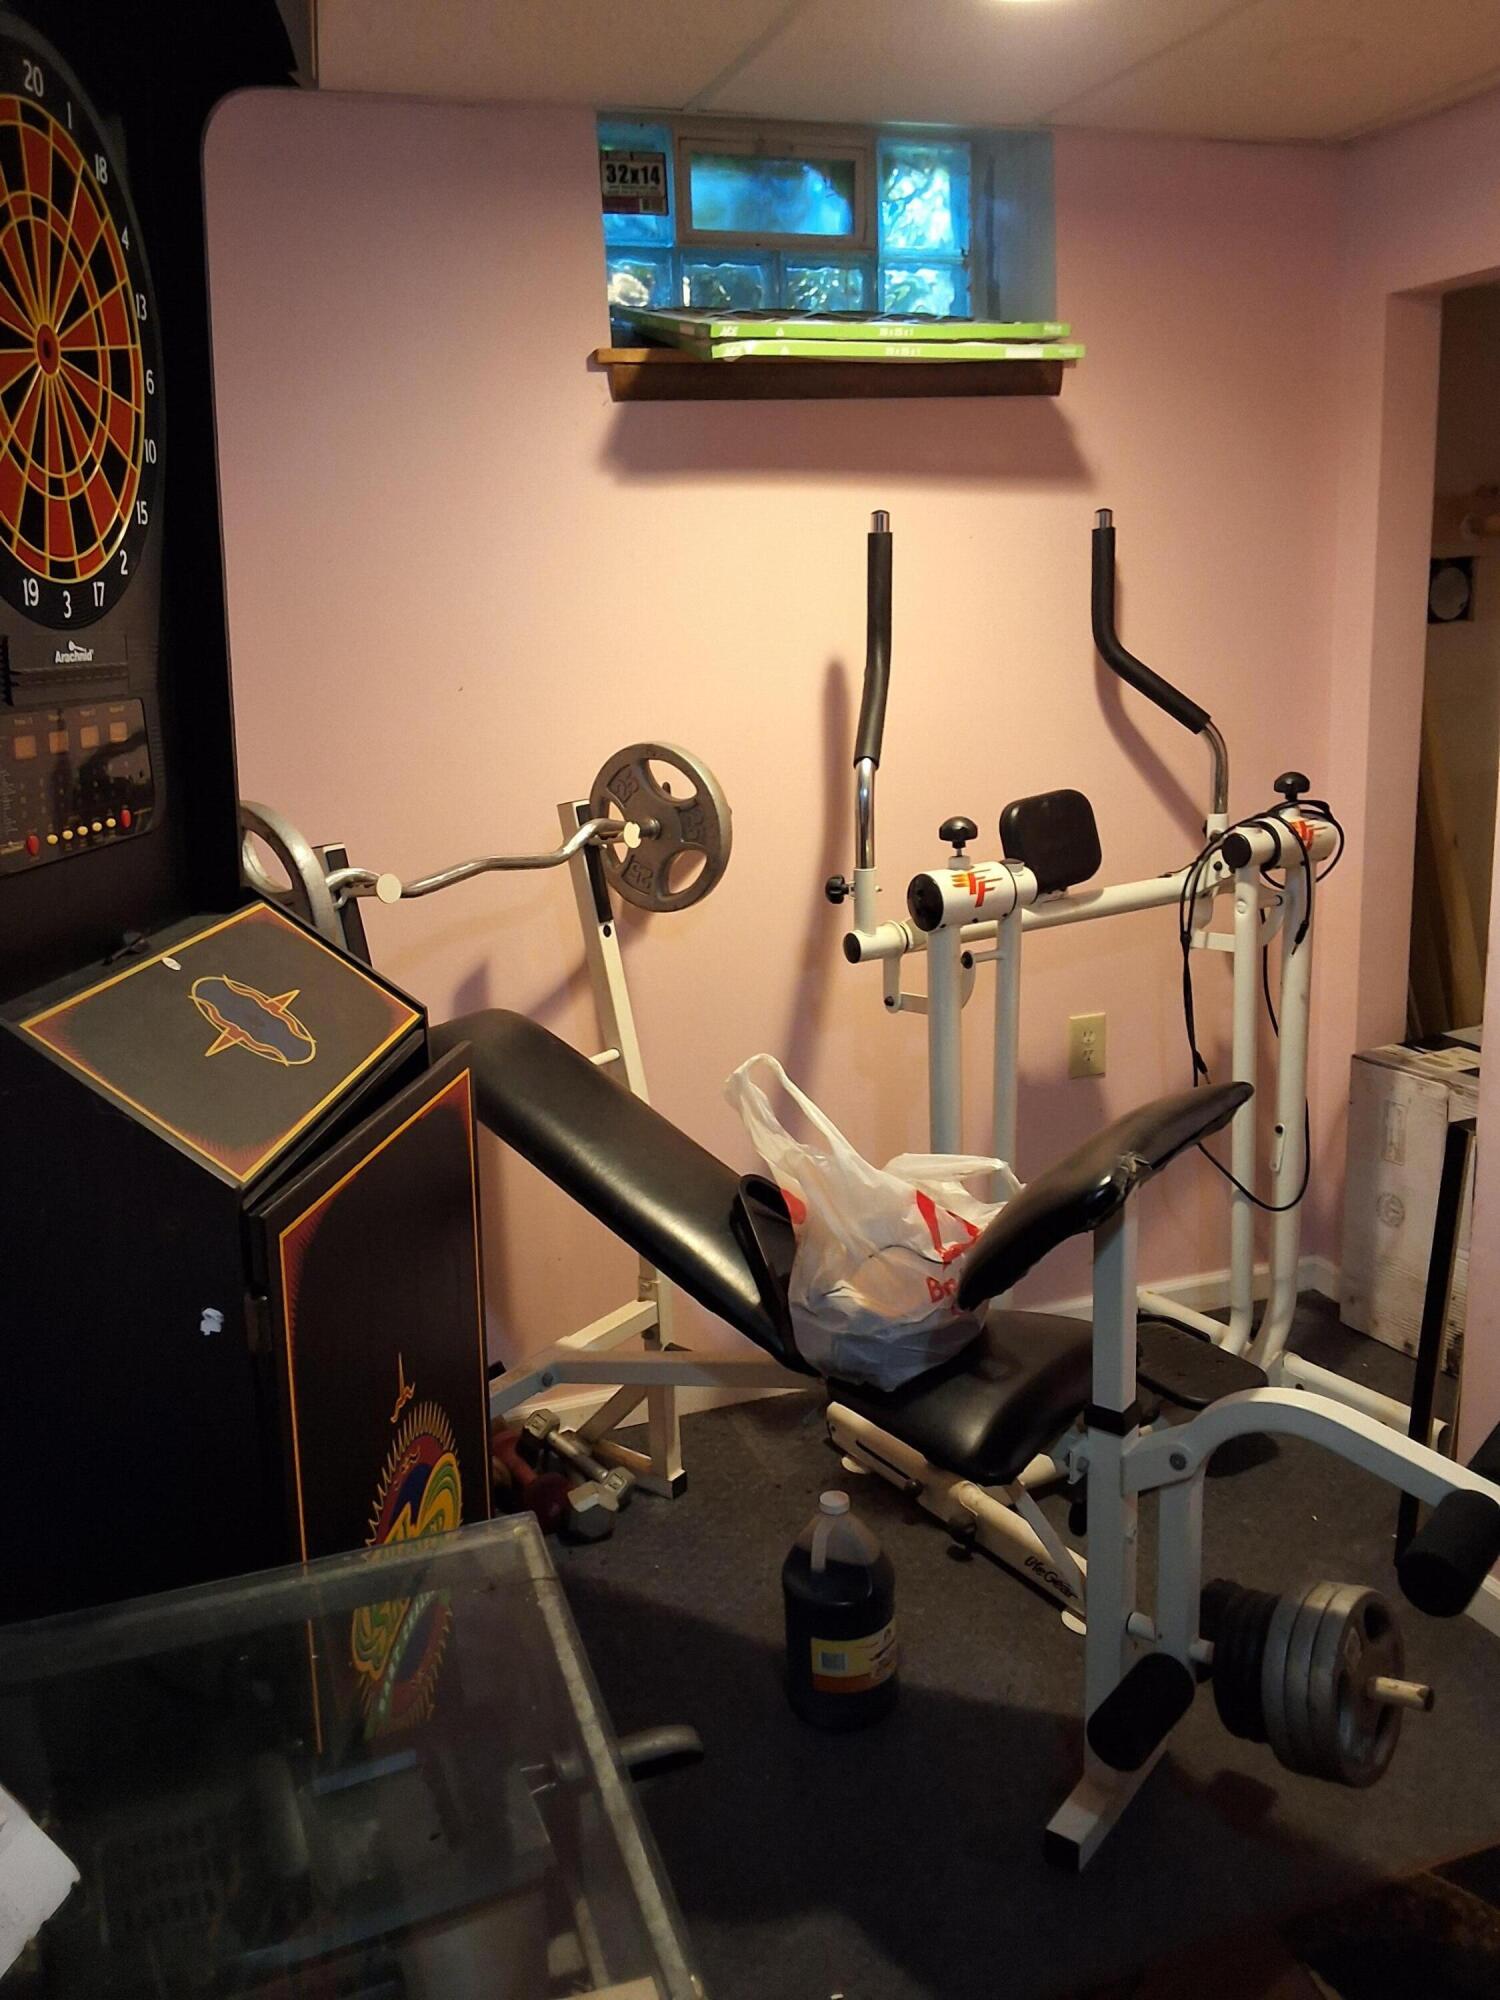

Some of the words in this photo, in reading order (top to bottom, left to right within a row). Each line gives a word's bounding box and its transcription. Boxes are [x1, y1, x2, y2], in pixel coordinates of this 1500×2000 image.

[23, 60, 44, 97] 20
[67, 101, 73, 130] 1
[95, 153, 108, 184] 18
[606, 163, 660, 185] 32x14
[121, 226, 129, 250] 4
[136, 293, 147, 320] 13
[146, 369, 155, 395] 6
[144, 439, 157, 464] 10
[137, 501, 148, 525] 15
[119, 550, 129, 575] 2
[23, 578, 40, 607] 19
[63, 590, 73, 619] 3
[93, 581, 105, 607] 17
[55, 649, 94, 663] Arachnid
